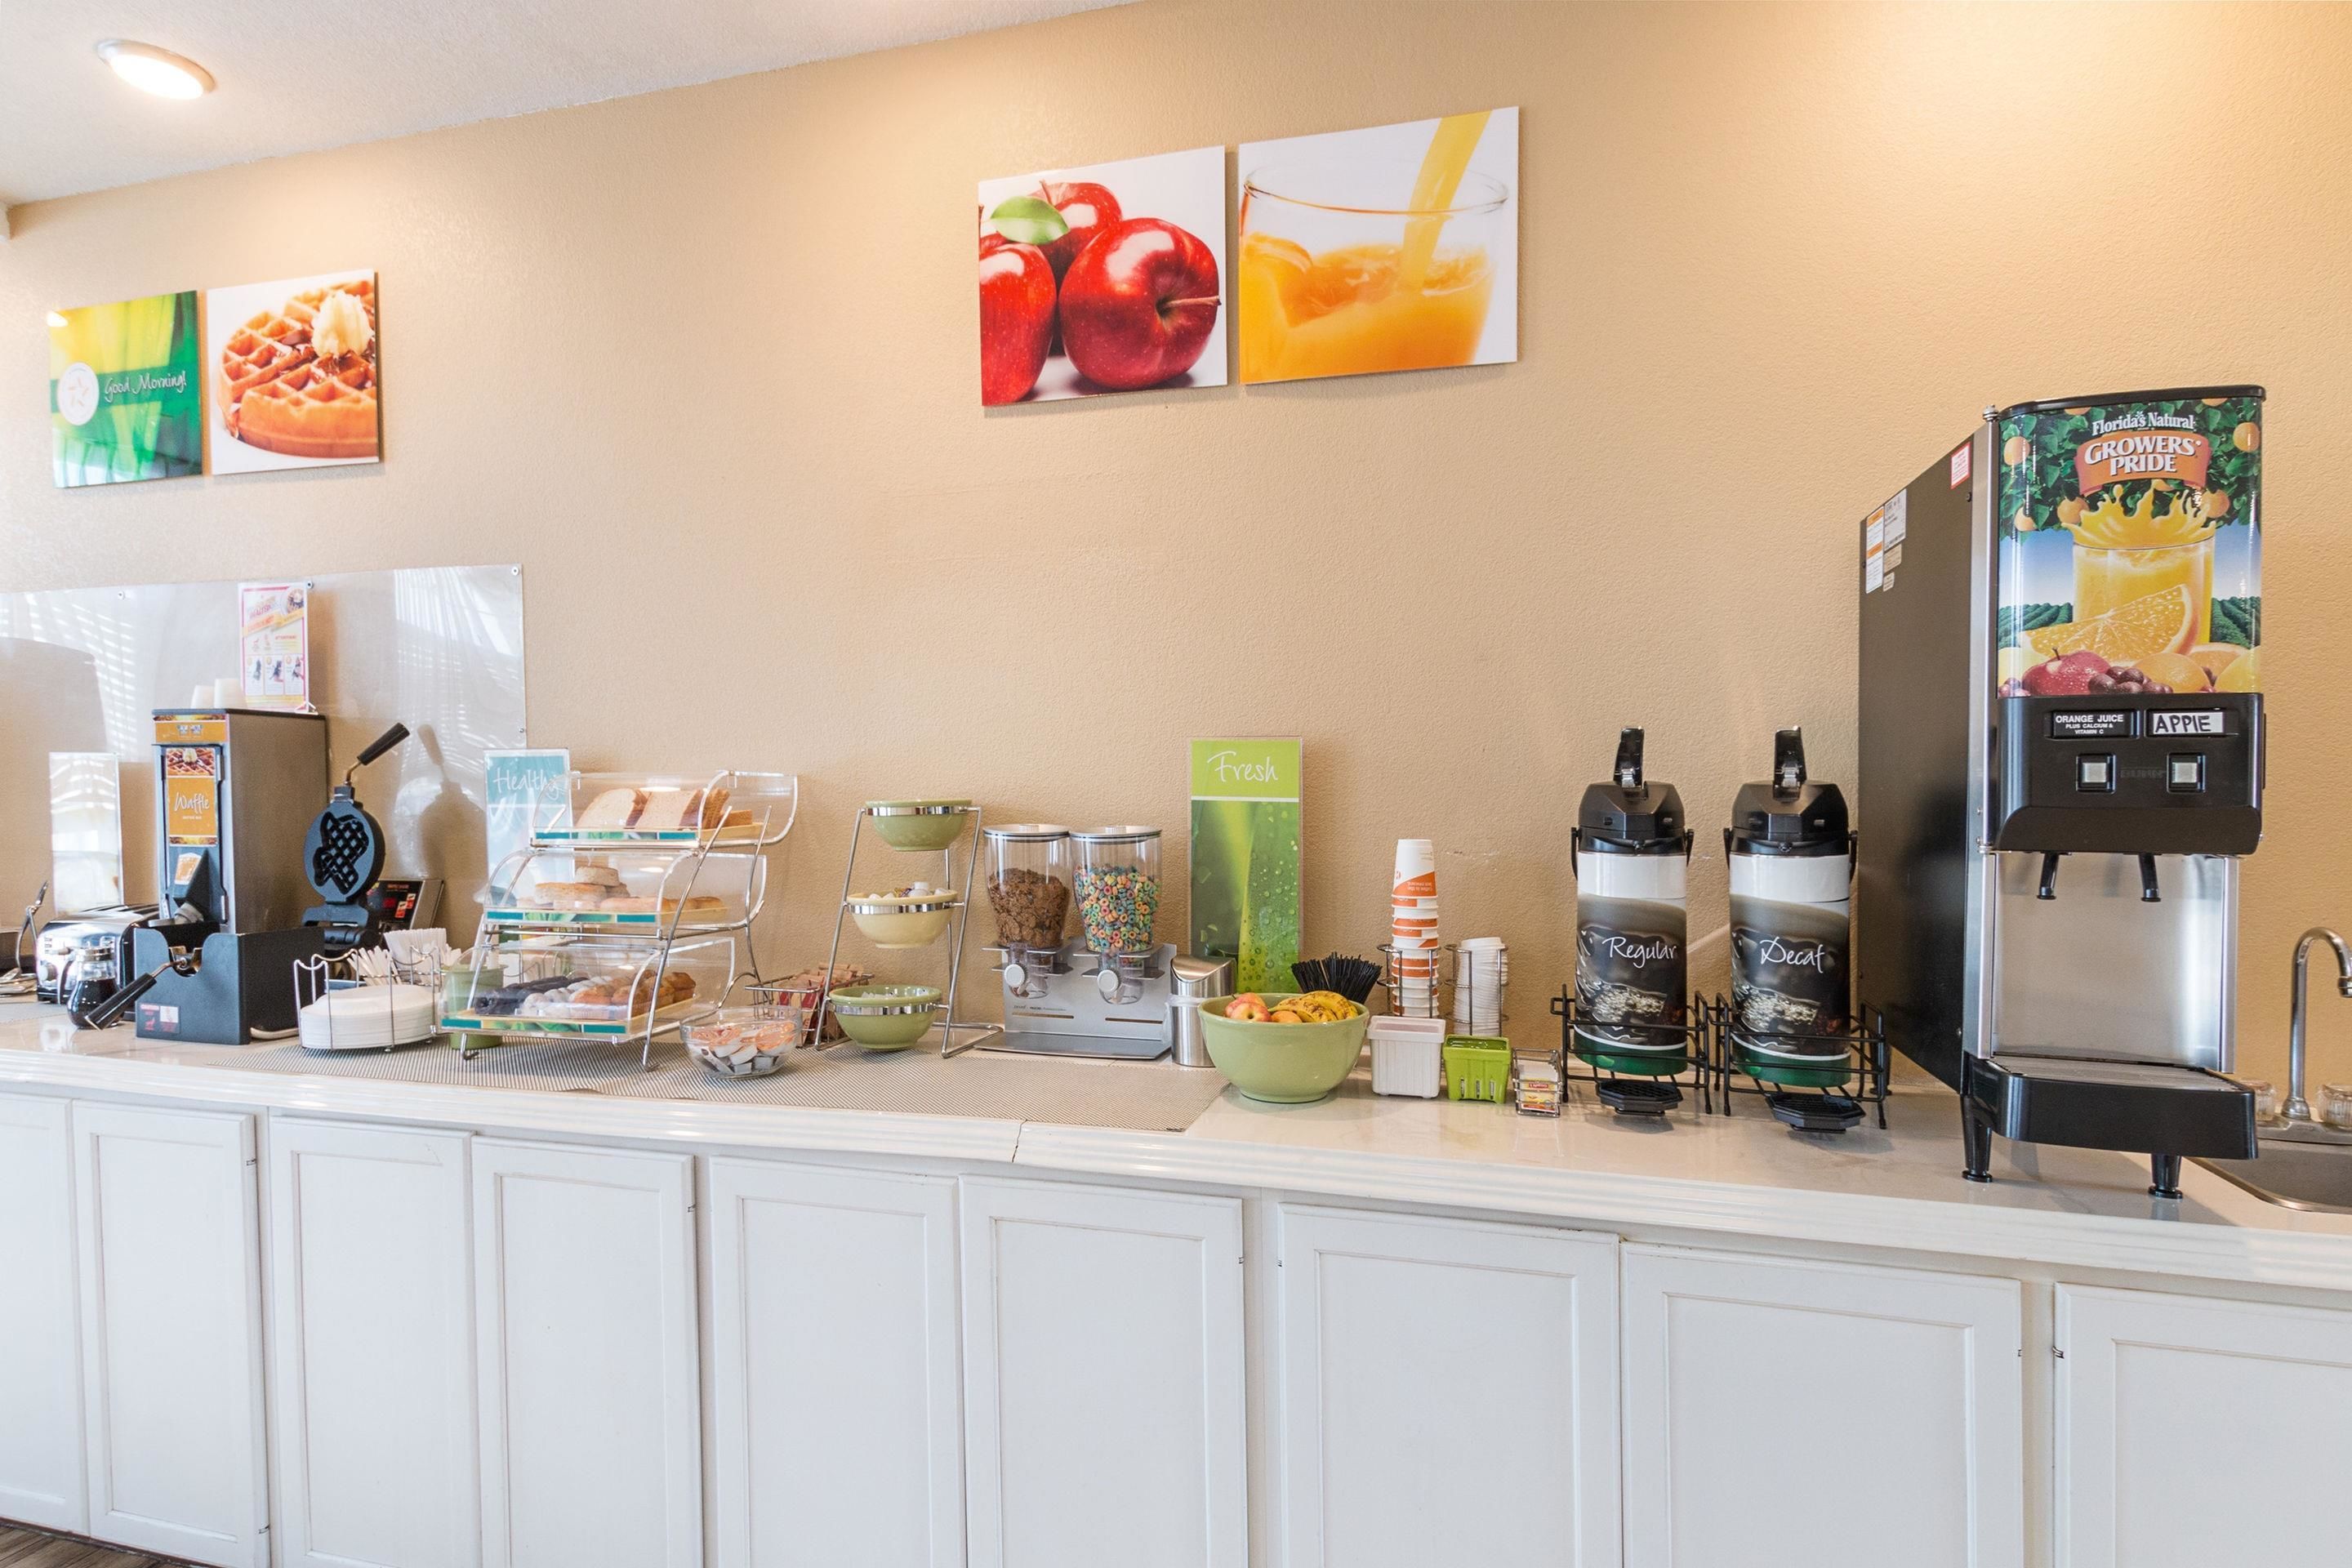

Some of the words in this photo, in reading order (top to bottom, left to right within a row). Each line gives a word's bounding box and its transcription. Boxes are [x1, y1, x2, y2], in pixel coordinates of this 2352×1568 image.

[104, 376, 131, 403] Good
[132, 370, 187, 394] Morning!
[2091, 411, 2146, 436] Florida's
[2148, 412, 2195, 430] Natural
[2109, 454, 2177, 476] PRIDE
[2055, 715, 2094, 724] ORANGE
[2096, 714, 2124, 723] JUICE
[1207, 751, 1278, 782] Fresh
[492, 767, 561, 800] Healthy
[174, 791, 210, 814] Waffle
[1601, 936, 1677, 969] Regular
[1760, 936, 1825, 973] Decaf
